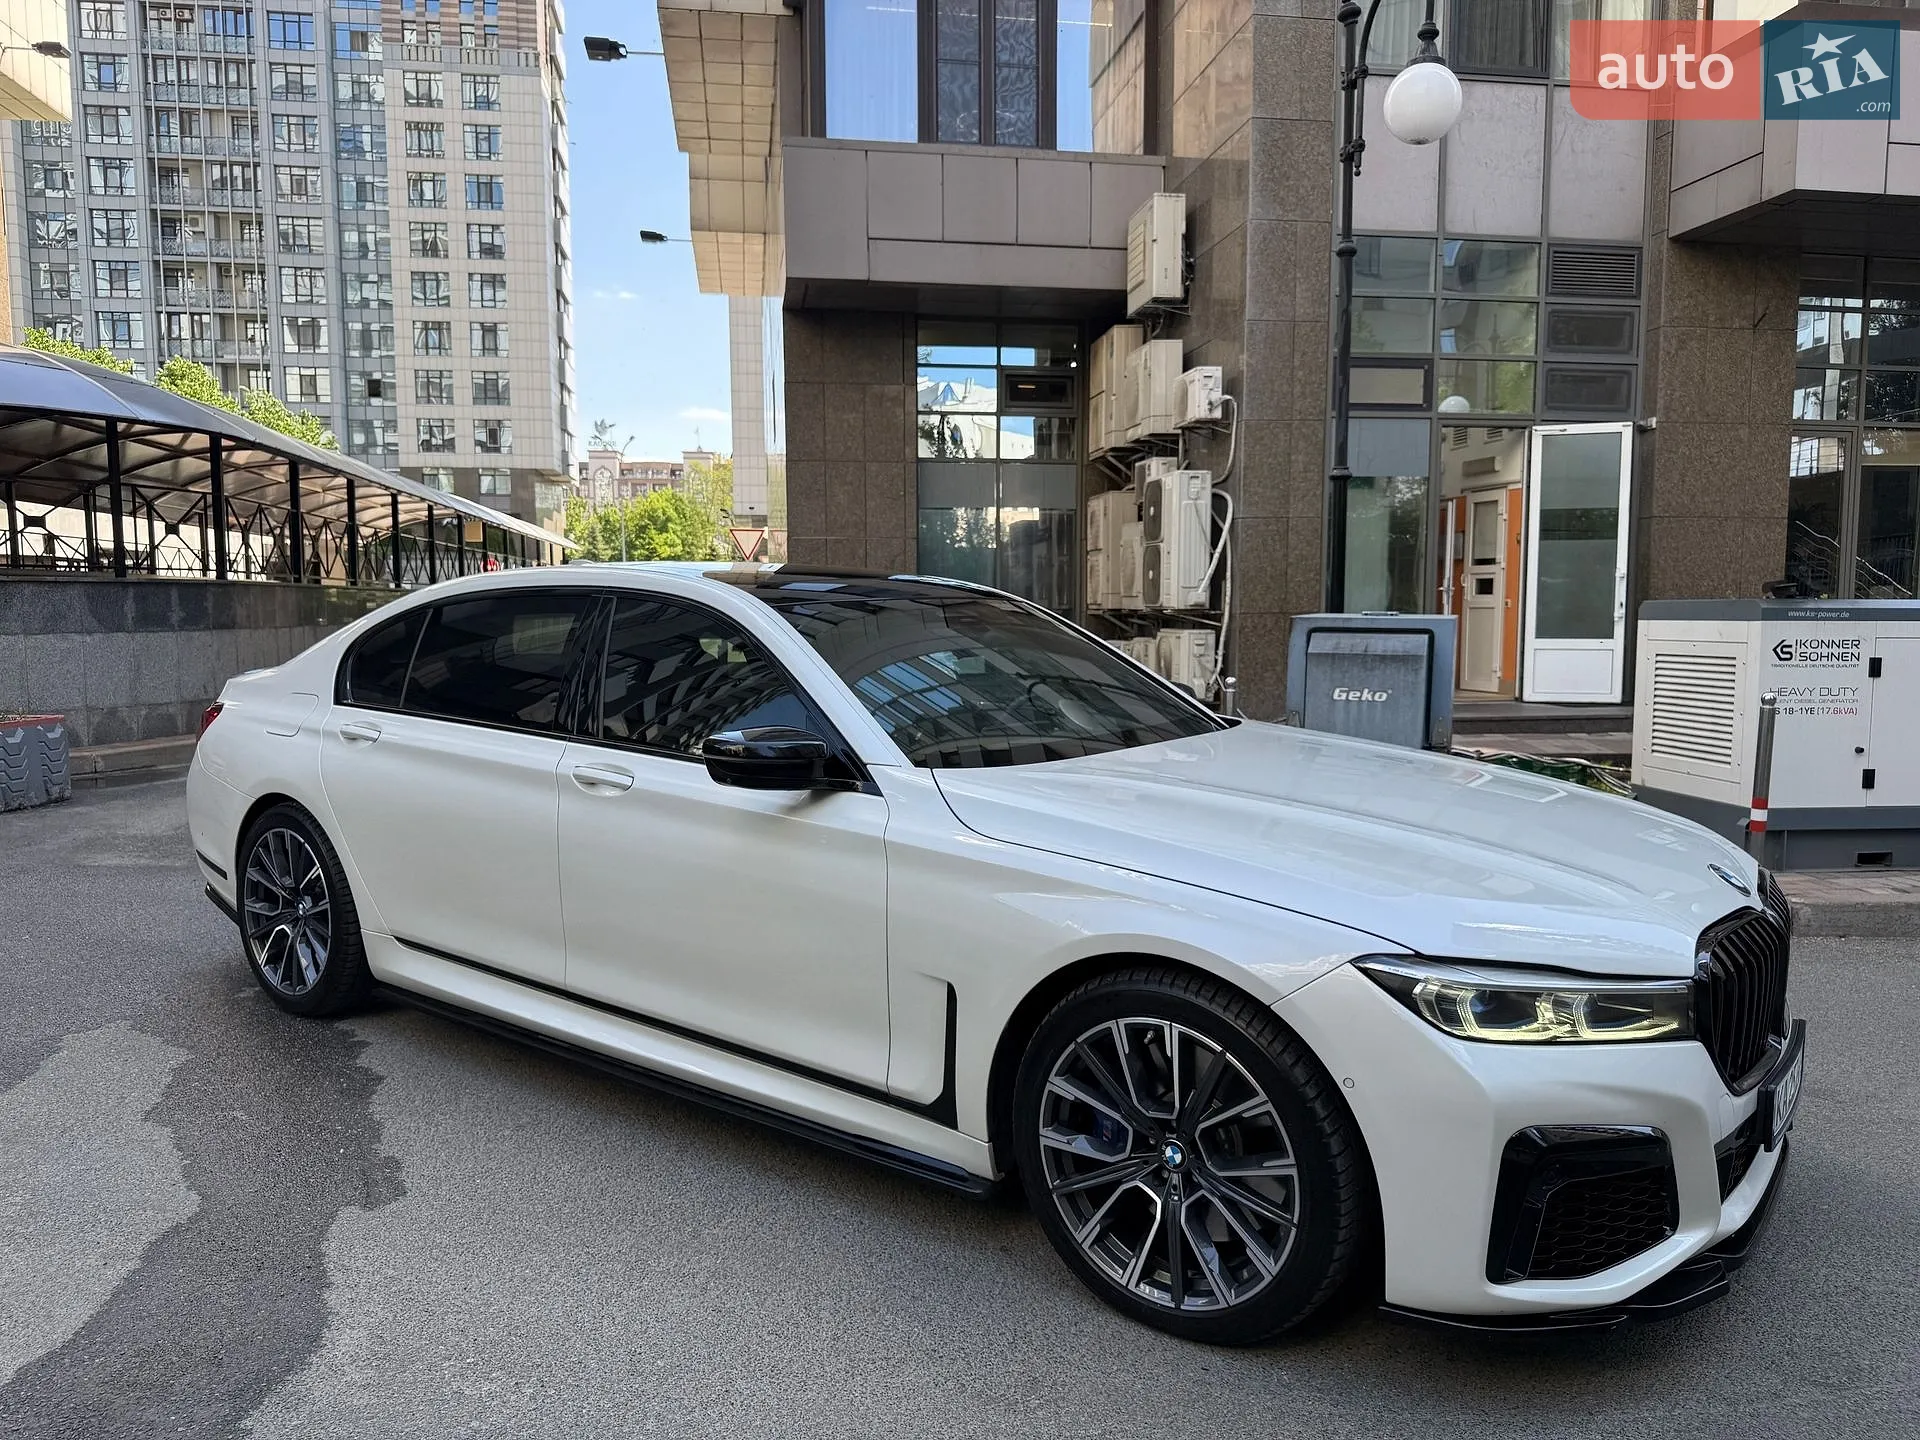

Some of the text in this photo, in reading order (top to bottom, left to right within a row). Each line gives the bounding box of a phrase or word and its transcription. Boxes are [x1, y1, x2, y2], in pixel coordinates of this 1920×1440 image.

[1332, 687, 1388, 702] Geko
[1770, 687, 1859, 697] HEAVY DUTY
